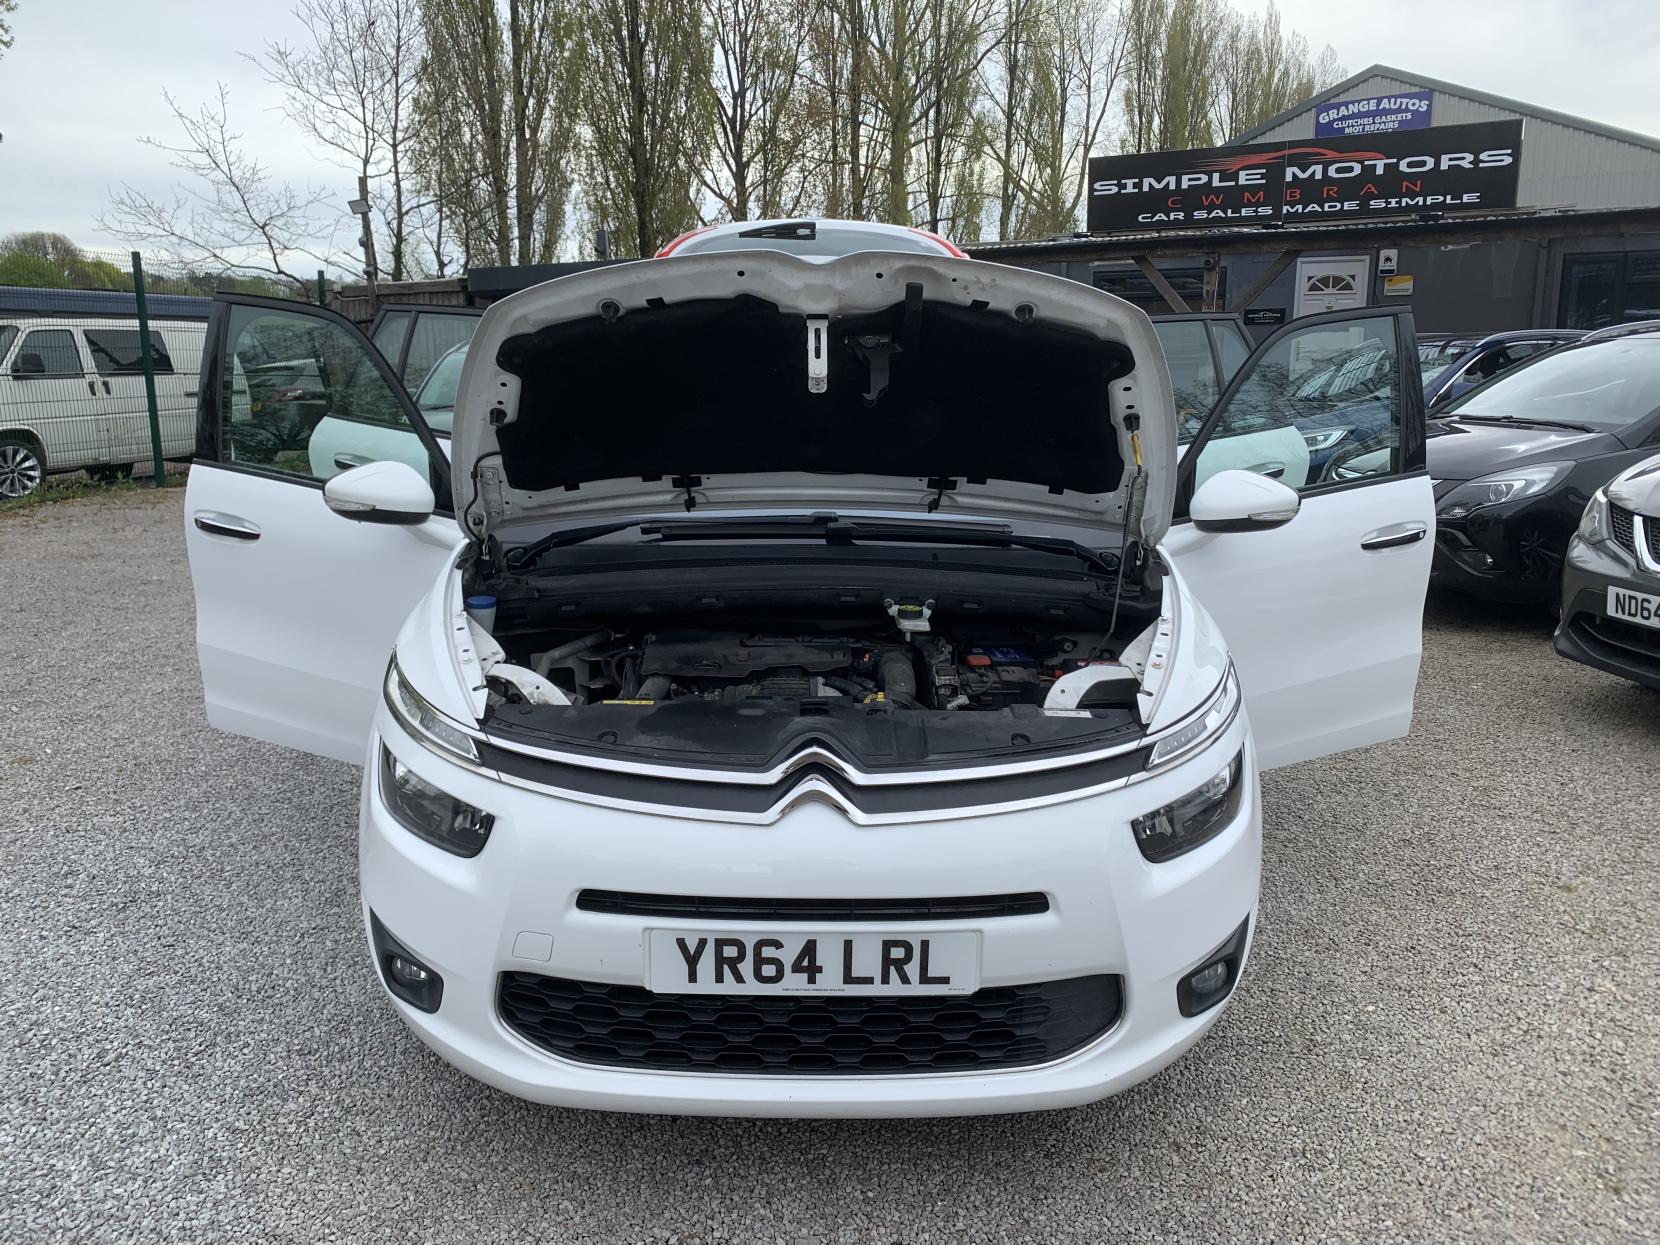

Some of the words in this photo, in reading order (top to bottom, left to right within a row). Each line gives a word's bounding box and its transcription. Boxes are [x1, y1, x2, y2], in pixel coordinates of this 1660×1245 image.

[1319, 99, 1377, 124] GRANGE
[1379, 98, 1429, 112] AUTOS
[1333, 117, 1374, 128] CLUTCHES
[1375, 112, 1412, 123] GASKETS
[1344, 125, 1364, 135] MOT
[1364, 121, 1399, 132] REPAIRS
[1093, 168, 1267, 196] SIMPLE
[1285, 149, 1513, 182] MOTORS
[1137, 212, 1185, 222] CAR
[1193, 206, 1273, 219] SALES
[1283, 200, 1360, 214] MADE
[1369, 193, 1481, 209] SIMPLE
[1167, 179, 1421, 208] CWMBRAN
[1615, 592, 1660, 624] ND64
[675, 937, 823, 985] YR64
[842, 939, 951, 985] LRL
